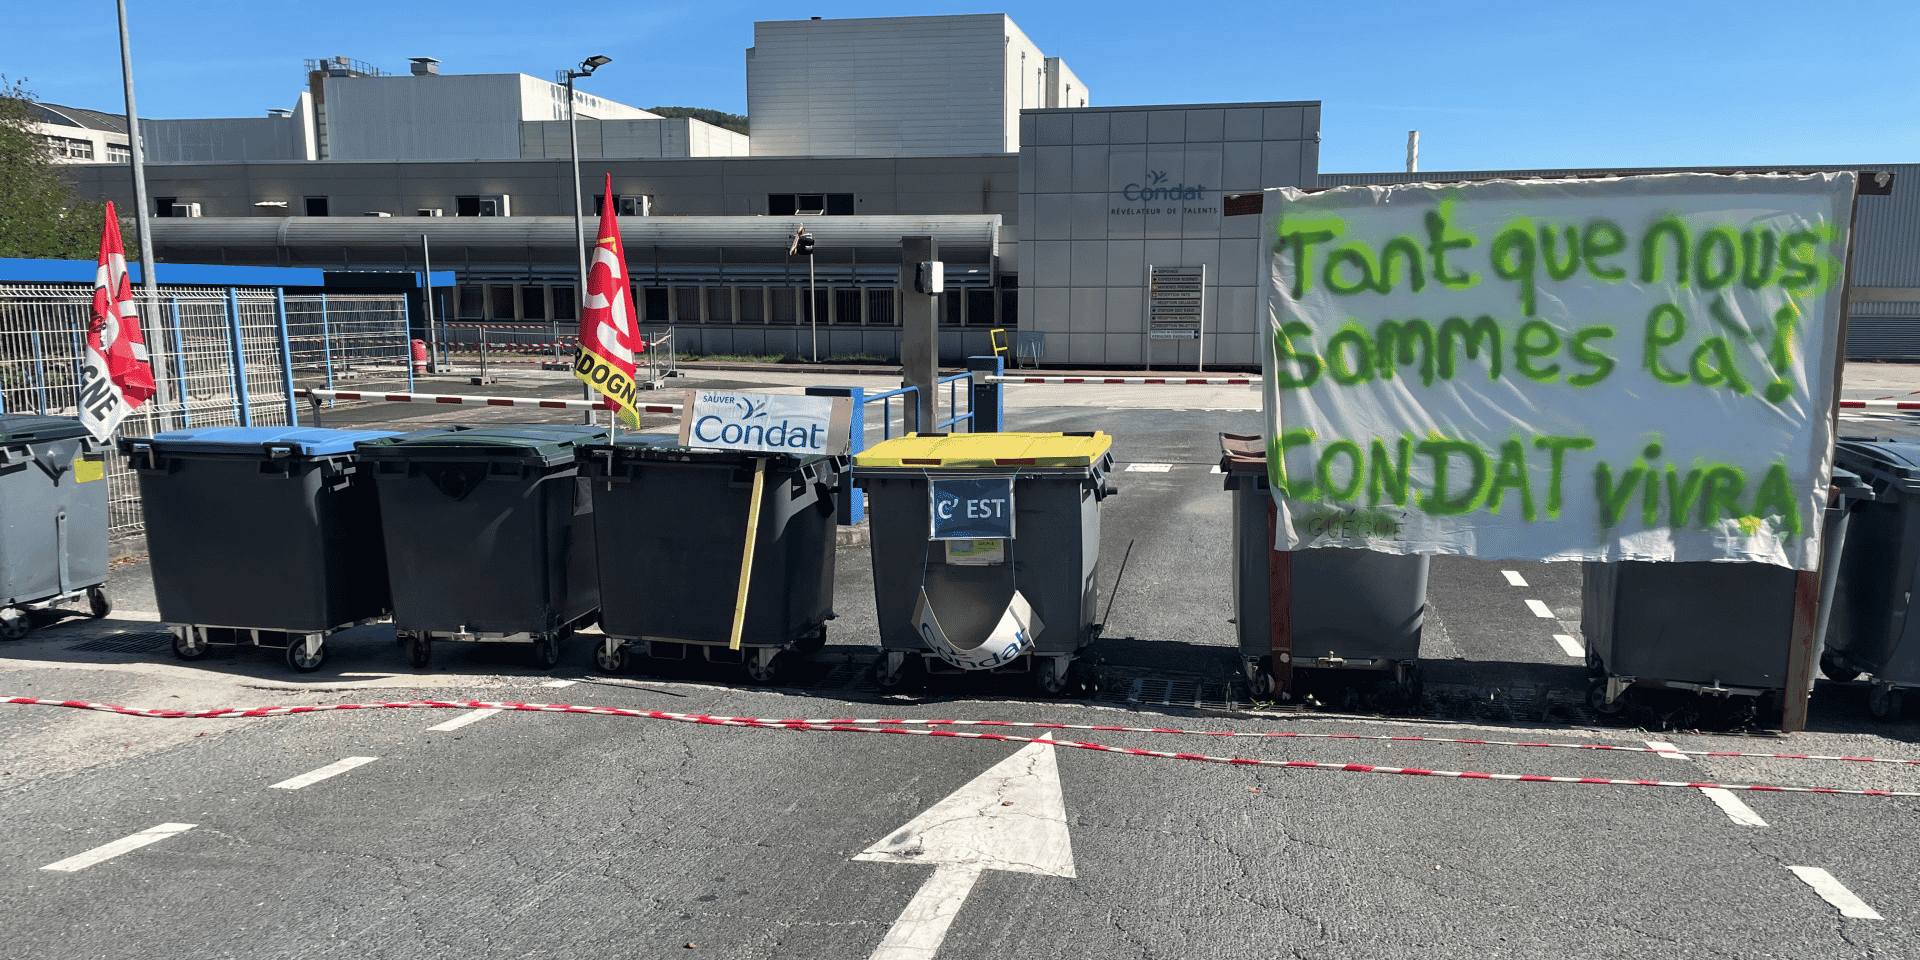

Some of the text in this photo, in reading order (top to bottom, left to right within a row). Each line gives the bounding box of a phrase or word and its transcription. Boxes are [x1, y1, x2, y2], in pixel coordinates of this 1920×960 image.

[1111, 207, 1161, 215] RÉVÉLATEUR
[1123, 183, 1206, 201] Condat
[1275, 203, 1830, 316] Tant que nous
[1277, 315, 1616, 388] sommes
[574, 348, 638, 413] RDOGN
[703, 395, 735, 404] SAUVER
[695, 415, 825, 449] Condat
[1268, 430, 1594, 521] CONDAT
[967, 499, 1005, 518] EST
[922, 622, 1030, 668] Condat
